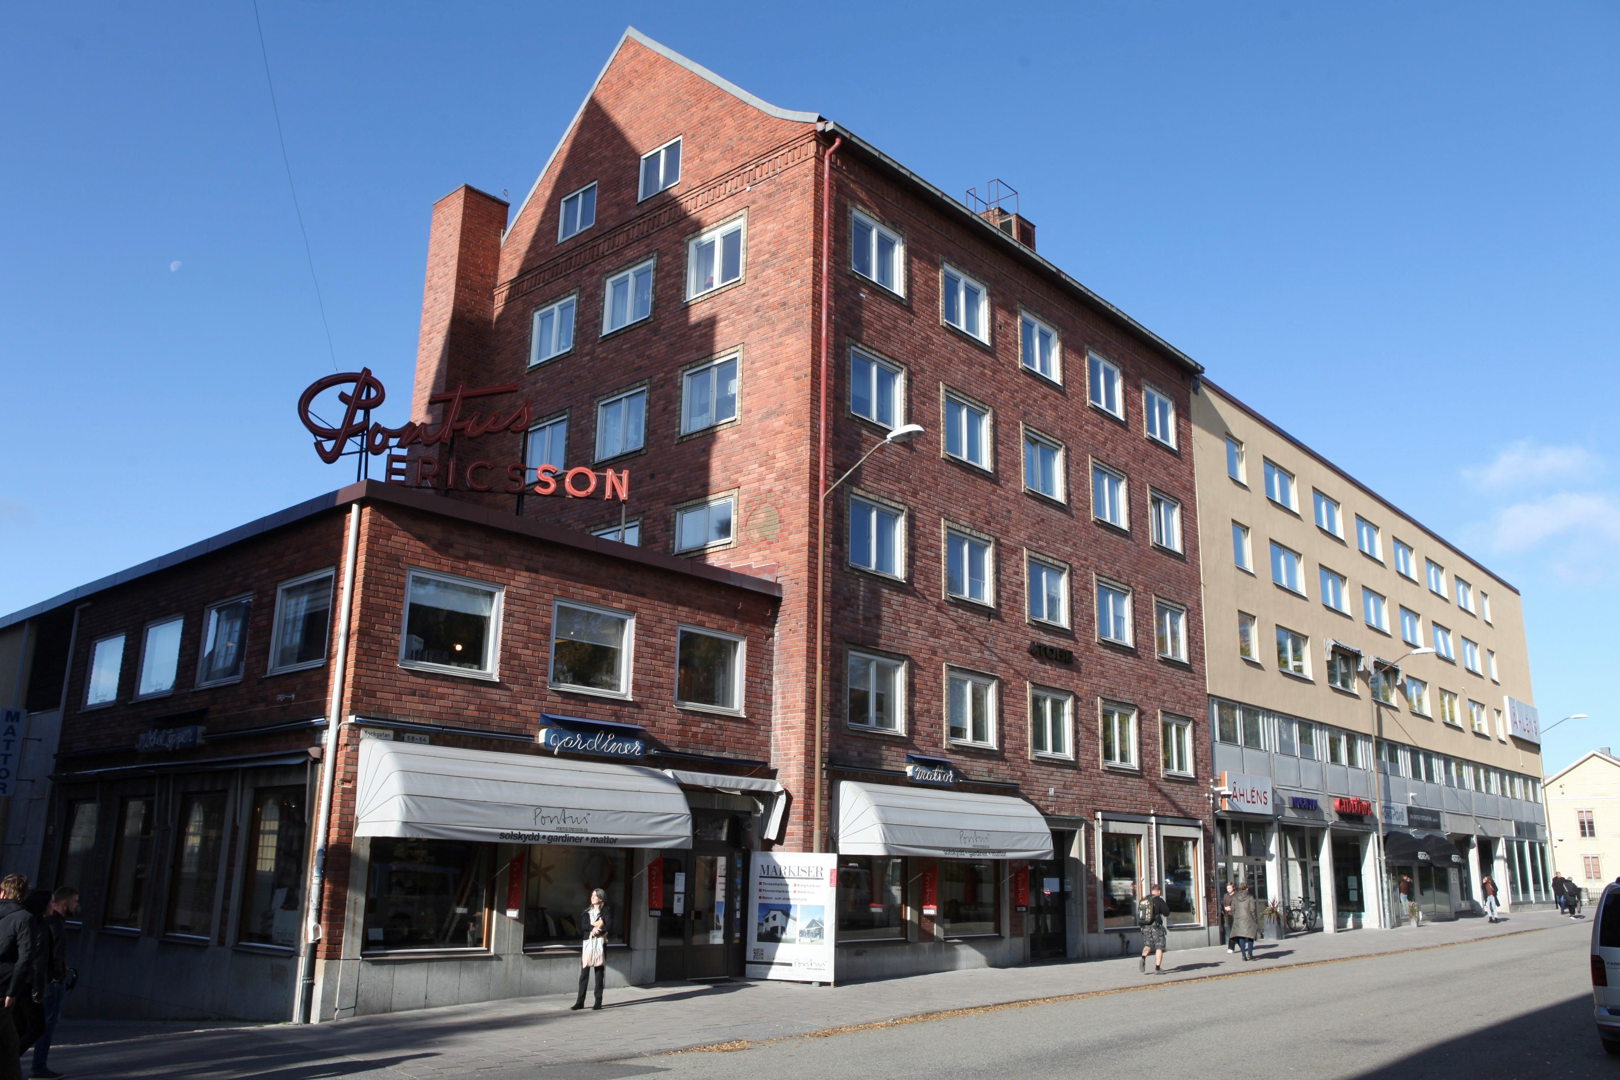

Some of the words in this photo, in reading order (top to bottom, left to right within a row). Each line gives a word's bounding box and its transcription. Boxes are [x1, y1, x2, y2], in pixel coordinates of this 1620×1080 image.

[298, 366, 532, 464] Pontus
[385, 454, 630, 502] ERICSSON
[1511, 706, 1538, 736] ÅHLÉNS
[363, 729, 391, 739] Kyrkgatan
[549, 730, 641, 756] gardiner
[0, 710, 21, 795] MATTOR
[915, 765, 954, 783] mattor
[1231, 781, 1268, 805] ÅHLÉNS
[499, 831, 540, 843] solskydd
[547, 834, 584, 844] gardiner
[590, 836, 619, 845] mattor
[760, 864, 824, 878] MARKISER
